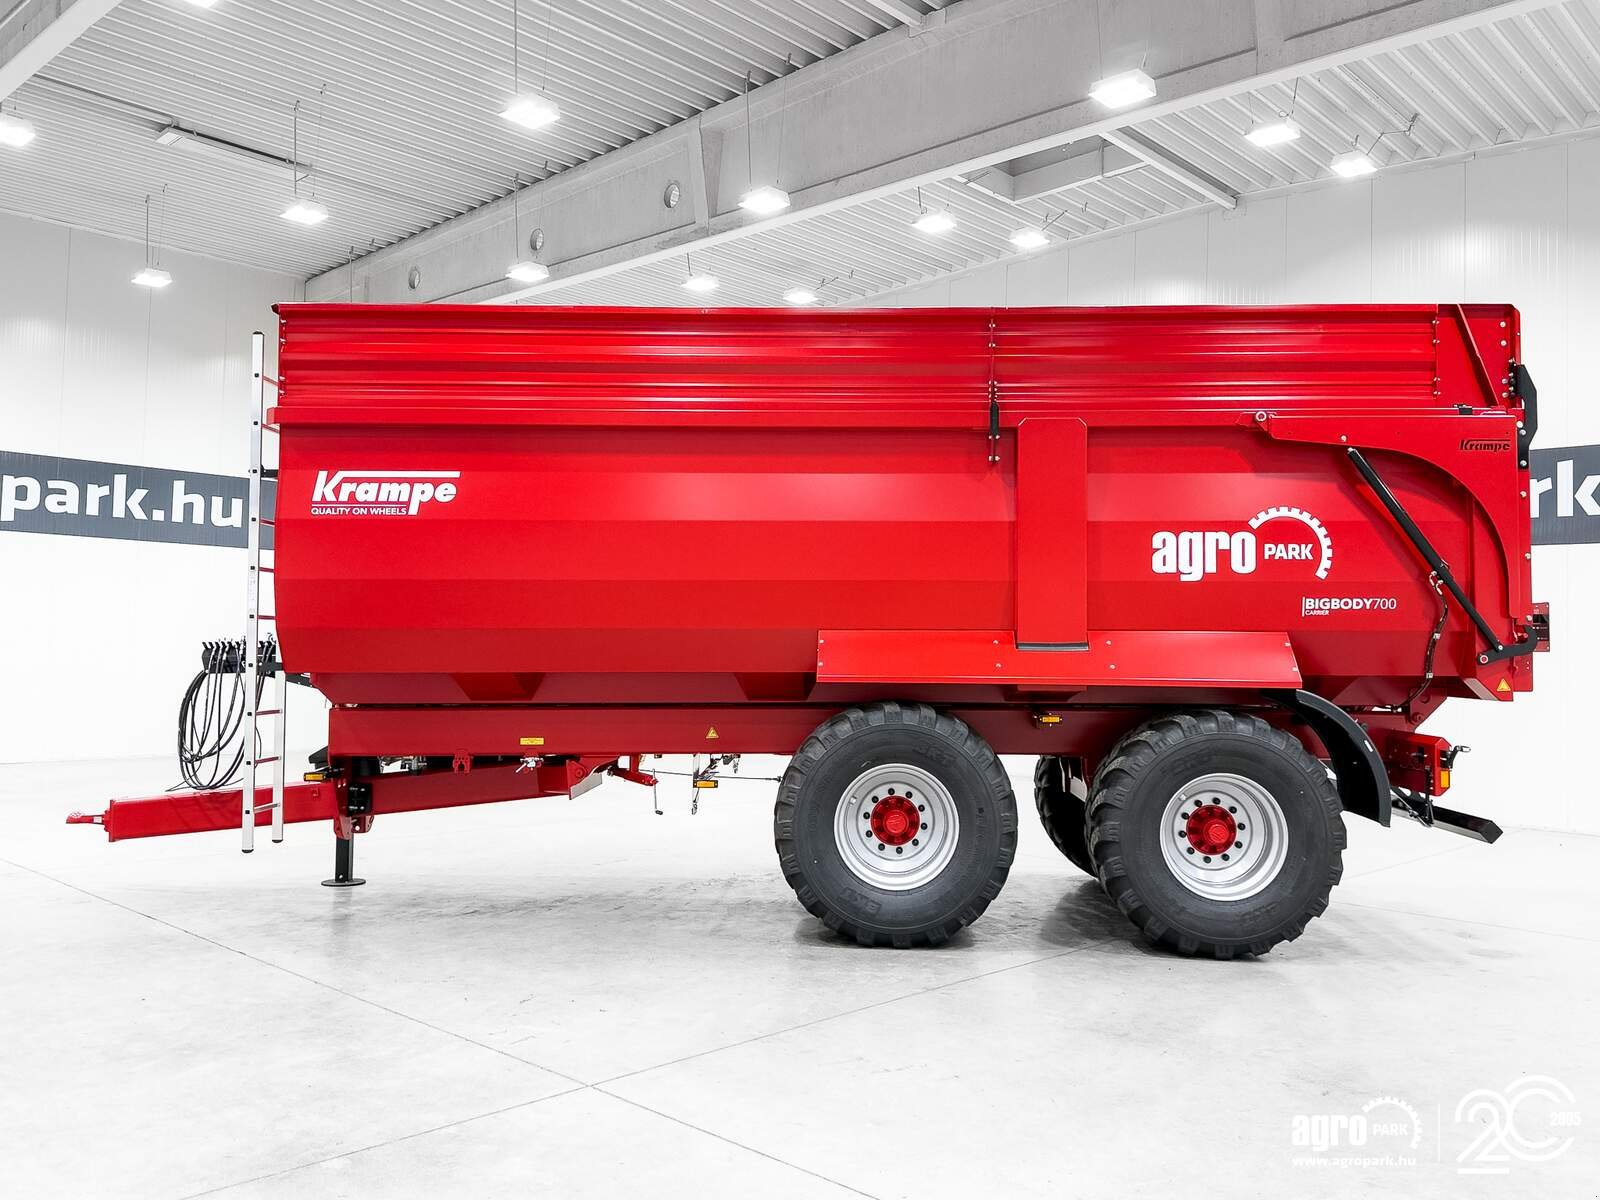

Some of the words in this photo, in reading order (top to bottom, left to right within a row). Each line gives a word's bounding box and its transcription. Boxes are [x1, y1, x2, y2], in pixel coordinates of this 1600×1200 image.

[0, 474, 244, 528] park.hu
[311, 470, 461, 515] Krampe
[1151, 530, 1256, 581] agro
[1263, 544, 1314, 561] PARK
[1305, 598, 1397, 610] BIGBODY700
